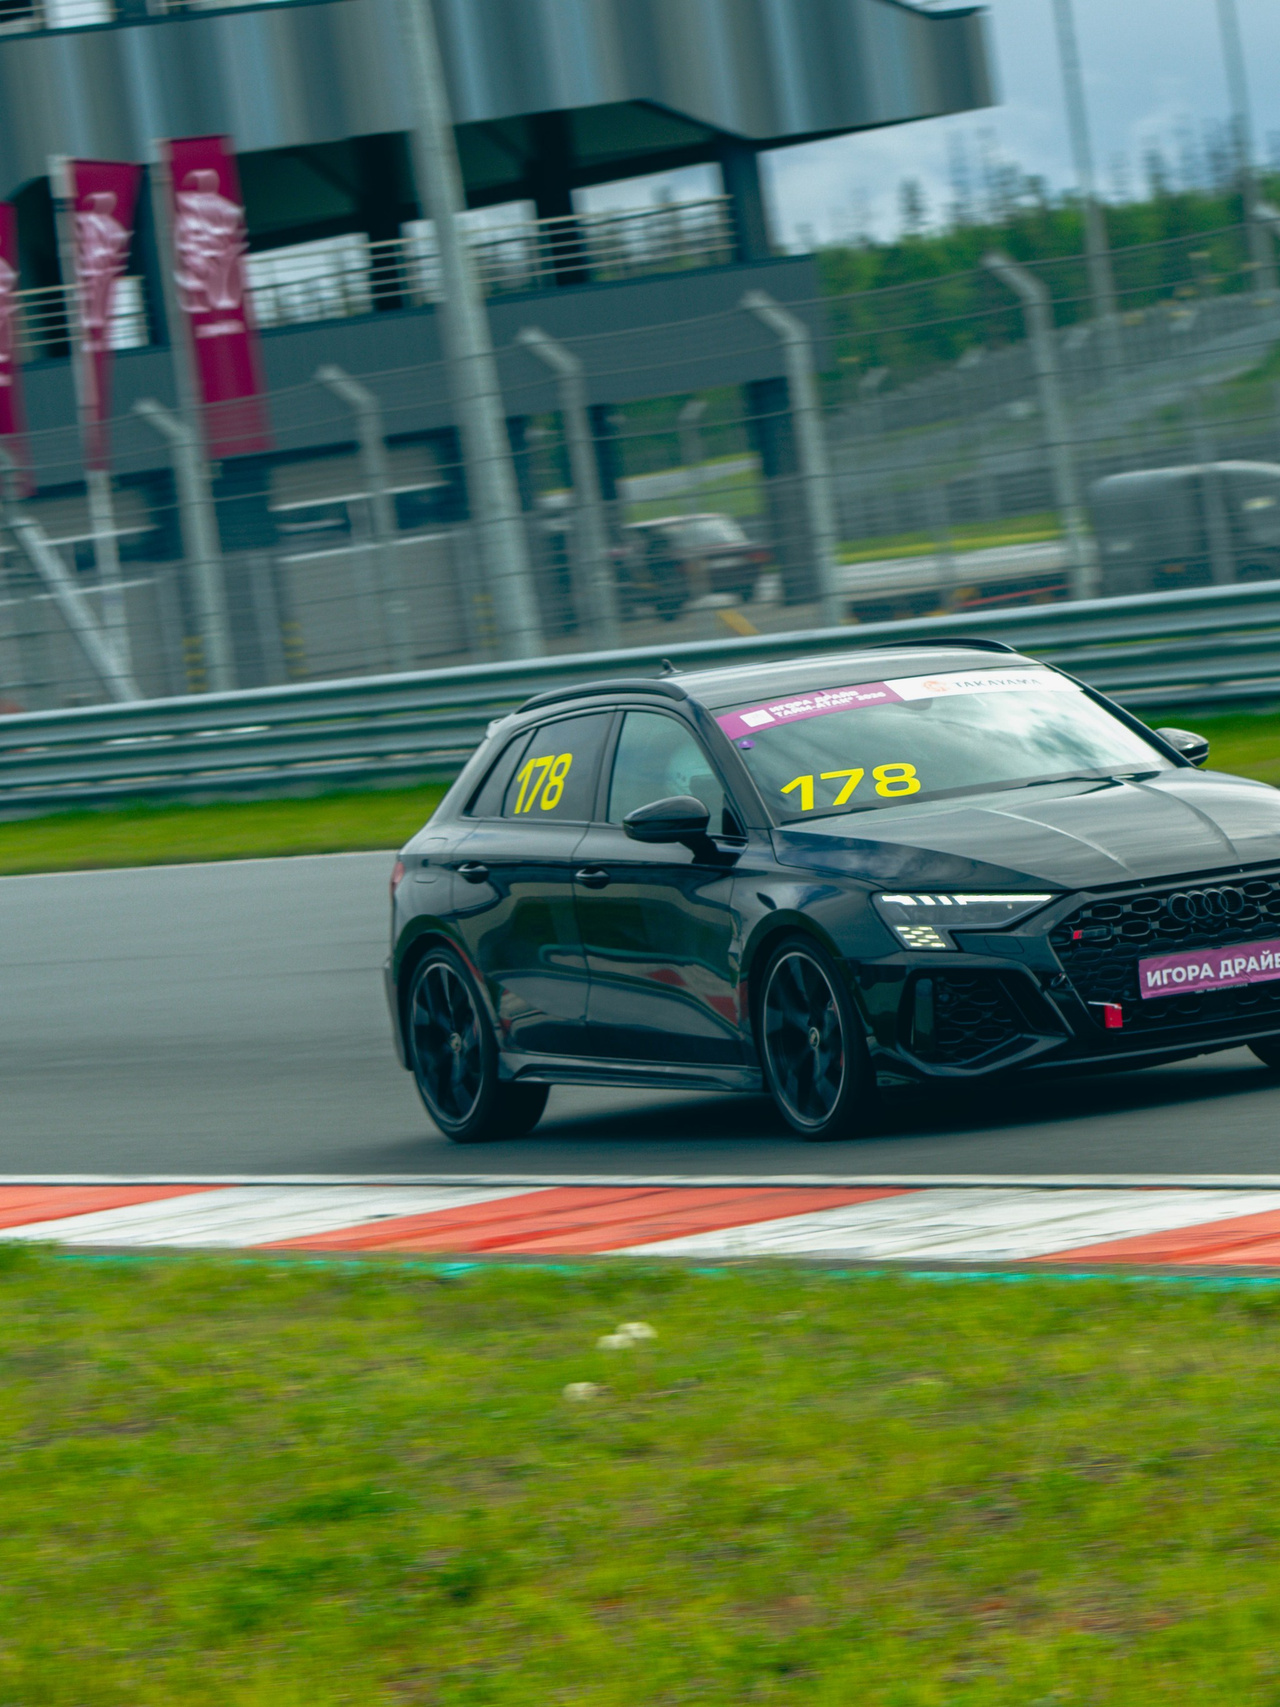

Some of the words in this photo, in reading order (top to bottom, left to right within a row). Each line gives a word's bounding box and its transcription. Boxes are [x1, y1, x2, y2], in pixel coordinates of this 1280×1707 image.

[953, 679, 1042, 688] TAKAYAMA
[769, 699, 813, 712] ИГОРА
[814, 690, 859, 703] ДРАЙВ
[514, 753, 573, 814] 178
[780, 763, 921, 811] 178
[1146, 963, 1214, 988] ИГОРА
